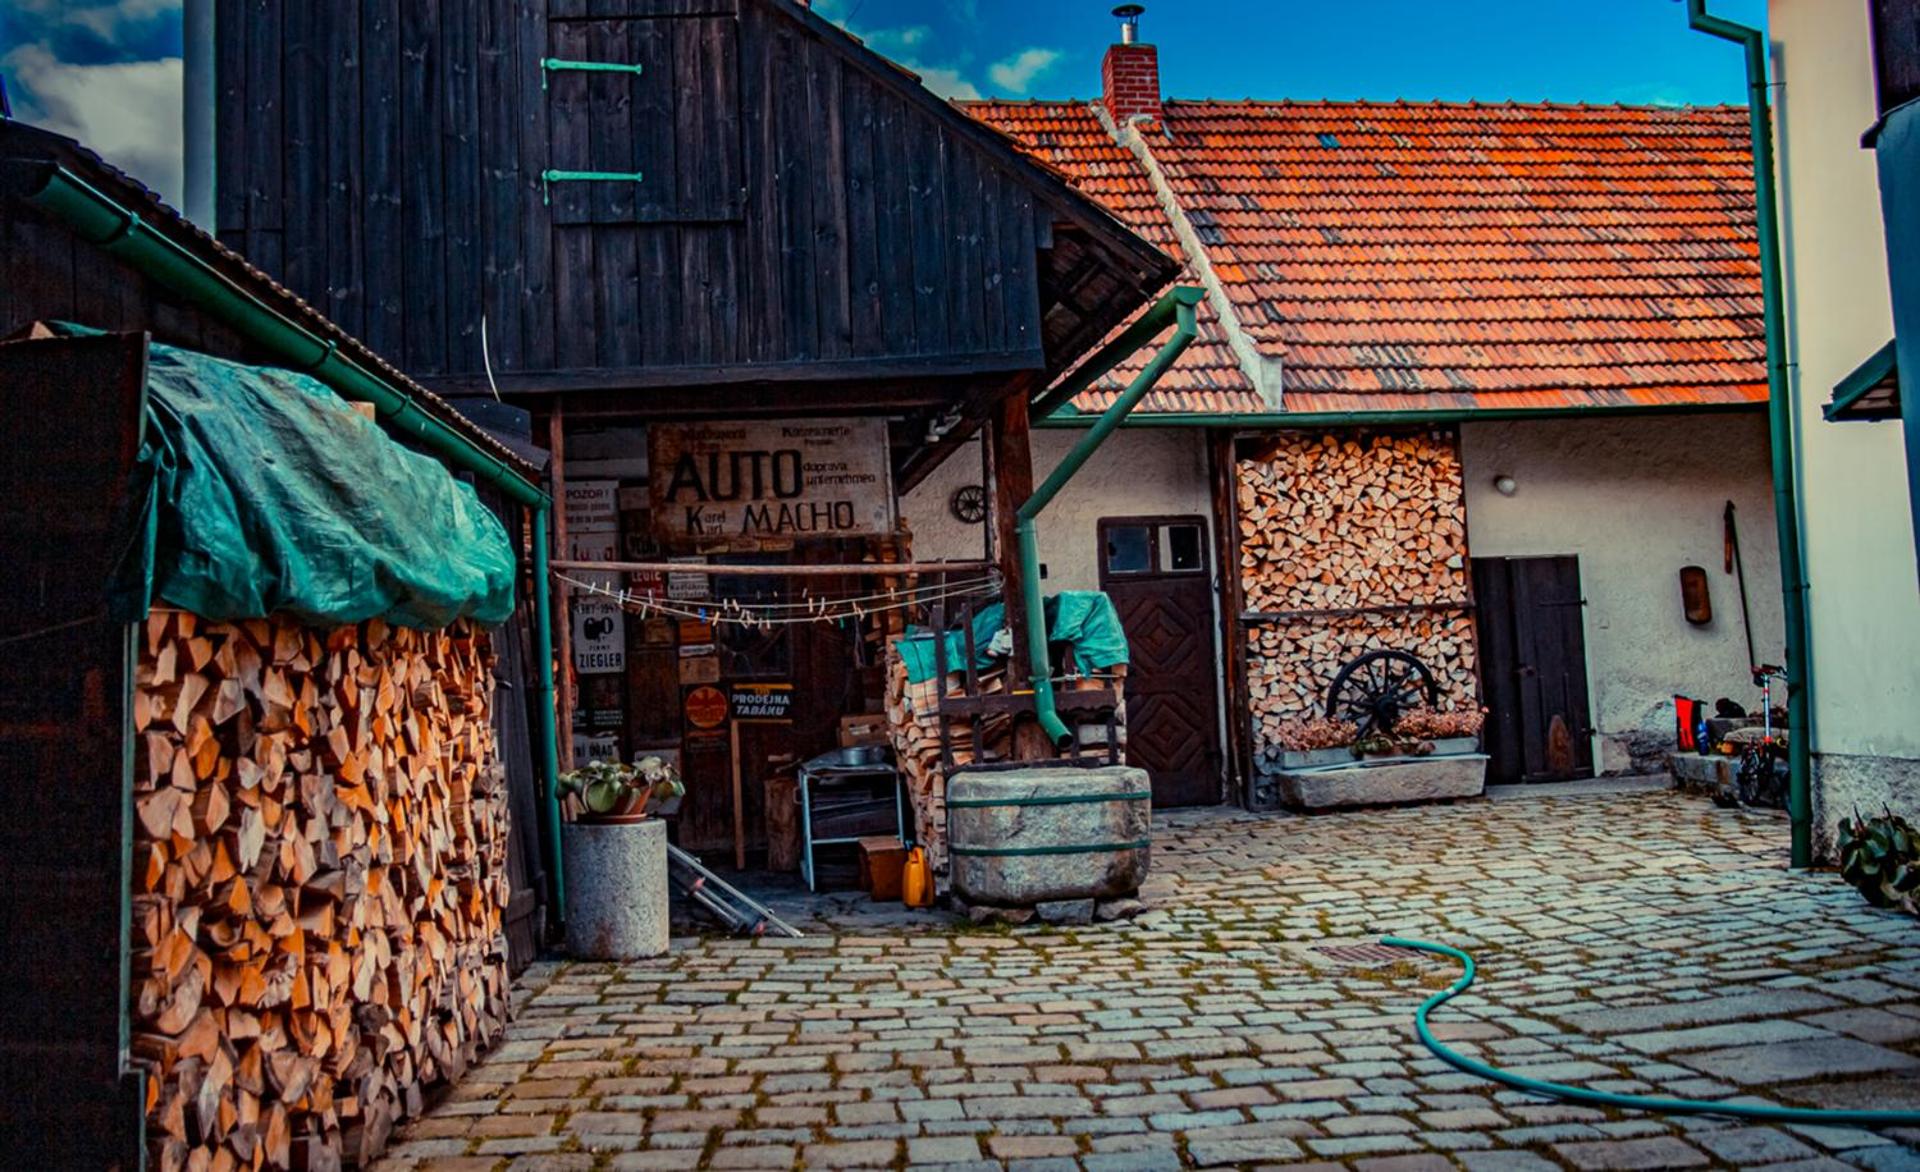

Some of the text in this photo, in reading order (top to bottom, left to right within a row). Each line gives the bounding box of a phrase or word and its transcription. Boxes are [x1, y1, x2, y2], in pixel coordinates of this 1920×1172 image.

[664, 449, 847, 502] AUTO doprava
[807, 473, 876, 485] unternehmen
[580, 653, 622, 668] ZIEGLER
[731, 694, 790, 705] PRODEJNA
[735, 705, 785, 716] TABÁKU
